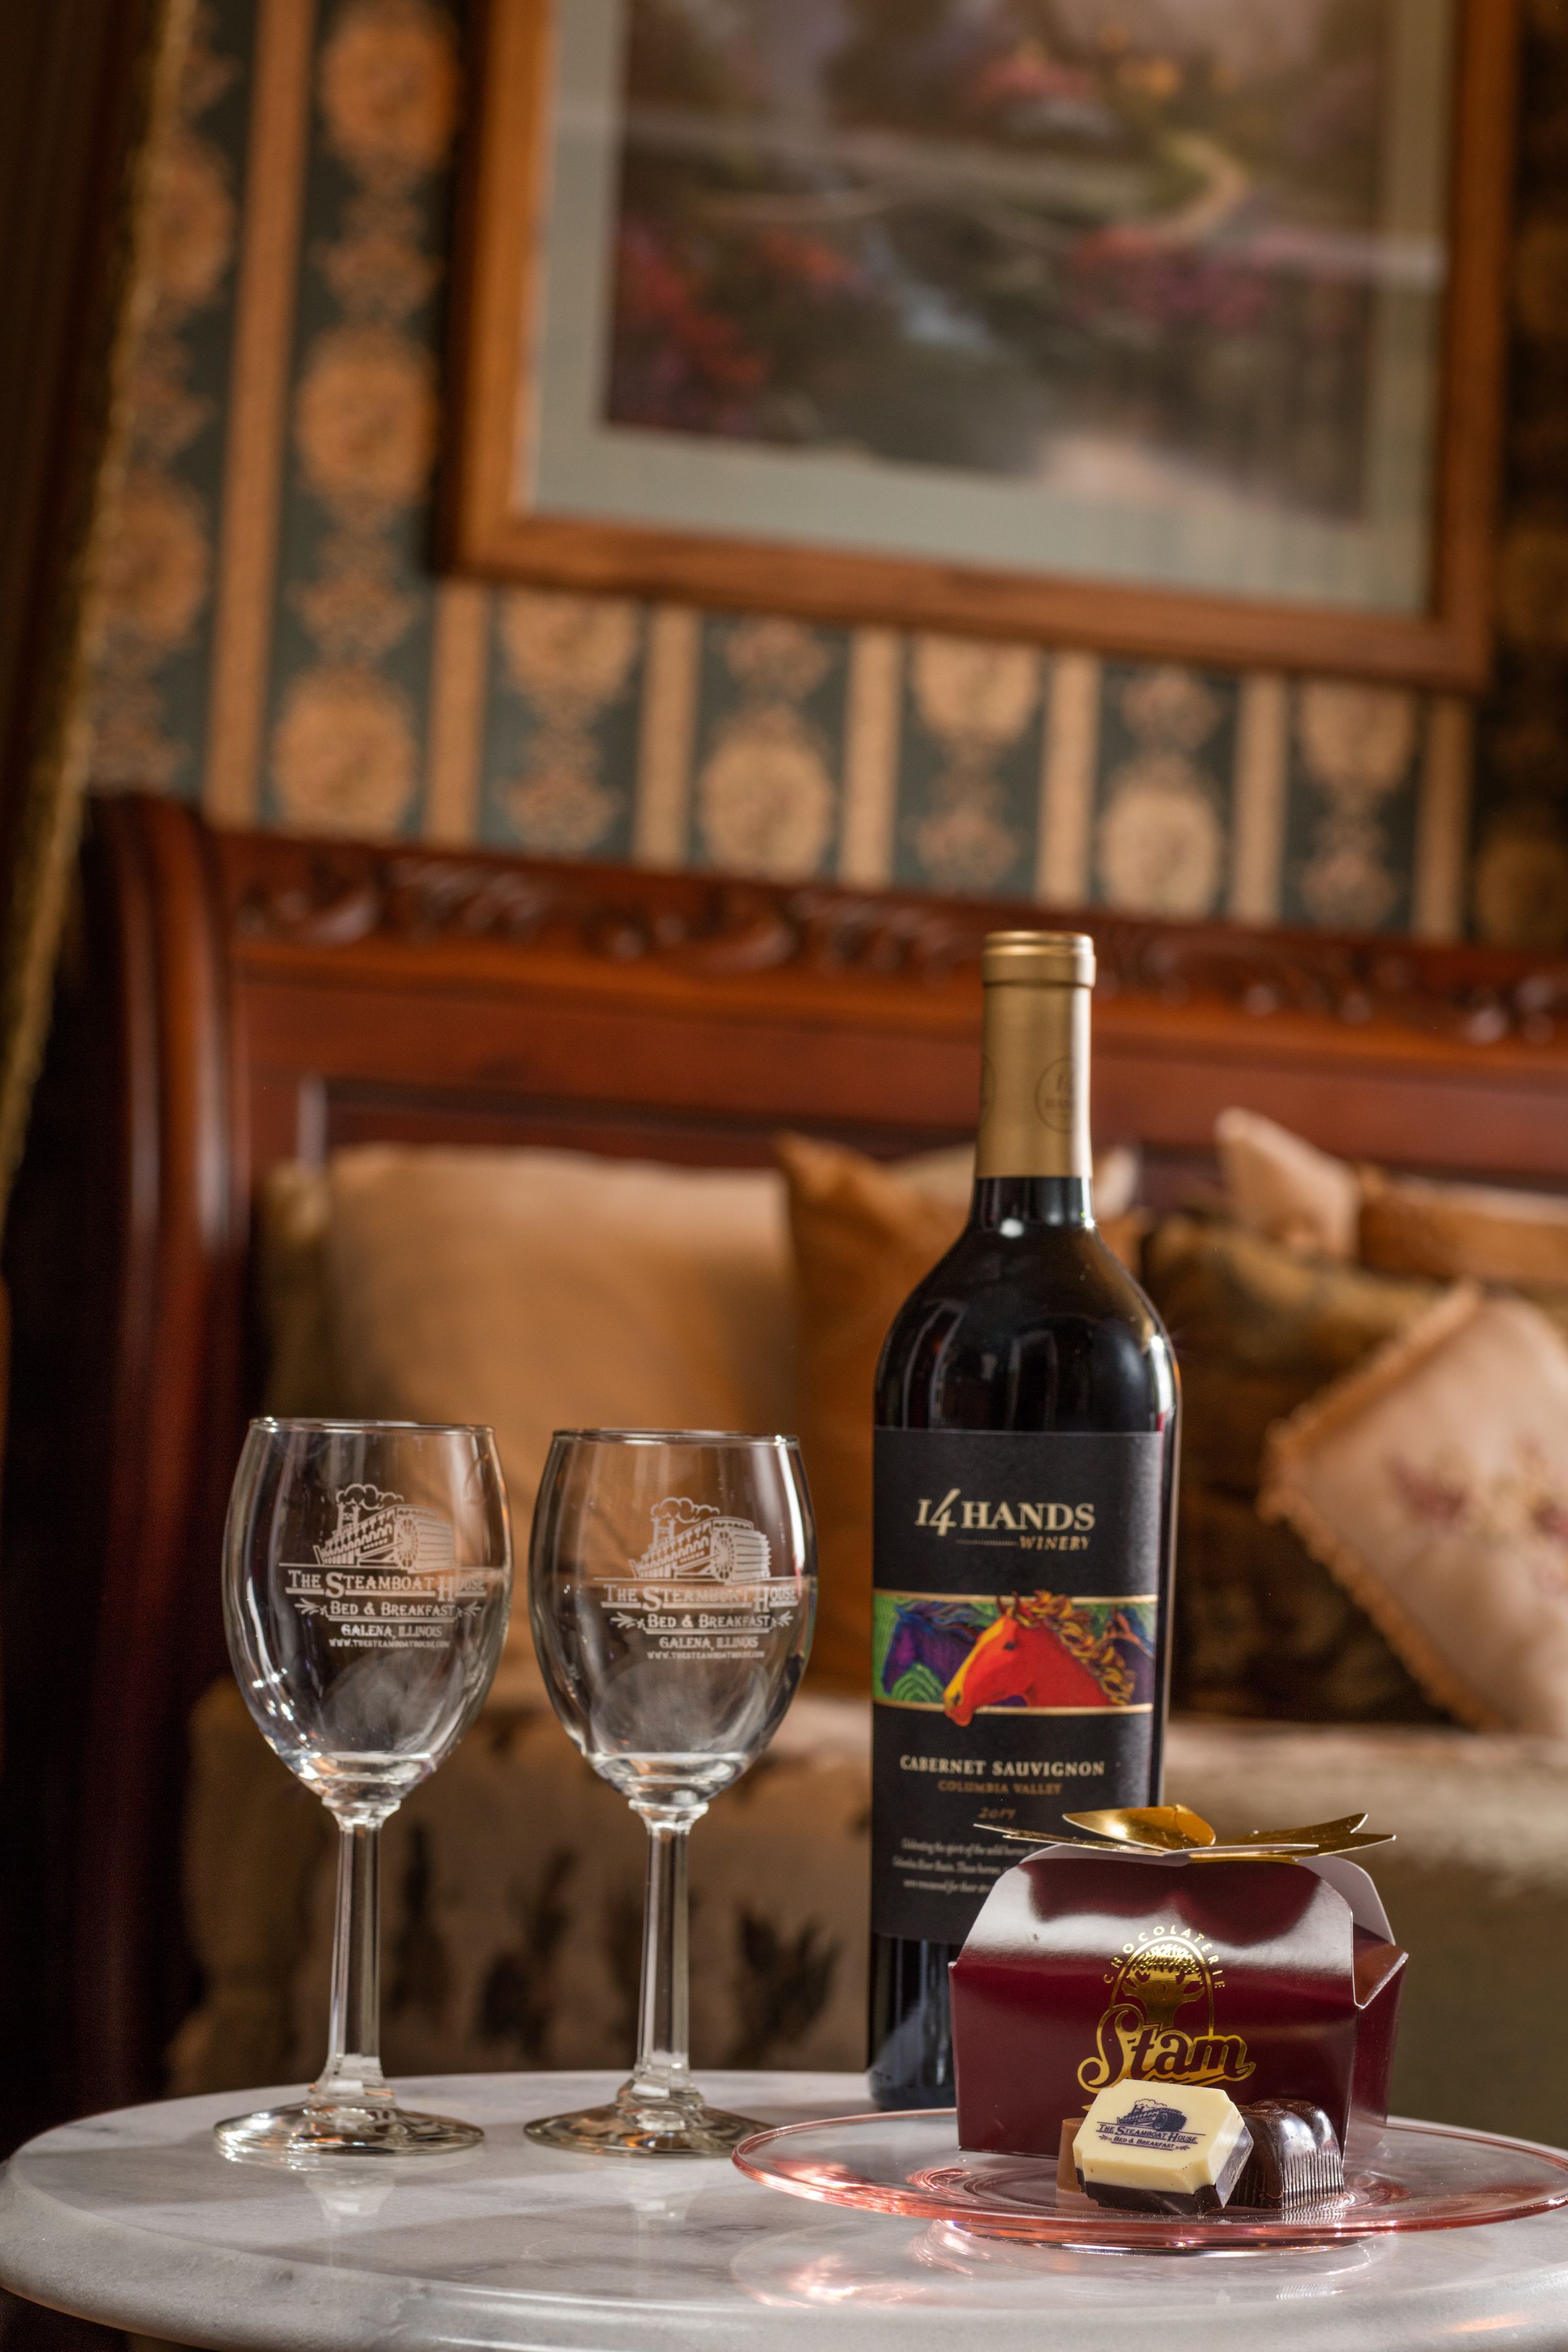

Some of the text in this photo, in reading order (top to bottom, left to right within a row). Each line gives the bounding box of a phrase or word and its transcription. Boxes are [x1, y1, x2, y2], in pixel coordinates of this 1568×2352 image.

[915, 1488, 1096, 1537] 14 HANDS
[1019, 1535, 1091, 1551] WINERY
[288, 1569, 321, 1589] THE
[325, 1571, 434, 1598] STEAMBOAT
[603, 1584, 798, 1612] THE STEAMBOAT HOUSE
[330, 1601, 455, 1617] BED & BREAKFAST
[647, 1614, 770, 1629] BED & BREAKFAST
[340, 1624, 443, 1640] GALENA, ILLINOIS
[659, 1636, 759, 1652] GALENA, ILLINOIS
[900, 1754, 1105, 1778] CABERNET SAUVIGNON
[938, 1780, 1062, 1795] COLUMBIA VALLEY
[1103, 1925, 1226, 1989] CHOCOLATERIE
[1077, 2003, 1256, 2095] Stam
[1099, 2123, 1198, 2143] THE STEAMBOAT HOUSE
[1136, 2138, 1175, 2149] BREAKFAST
